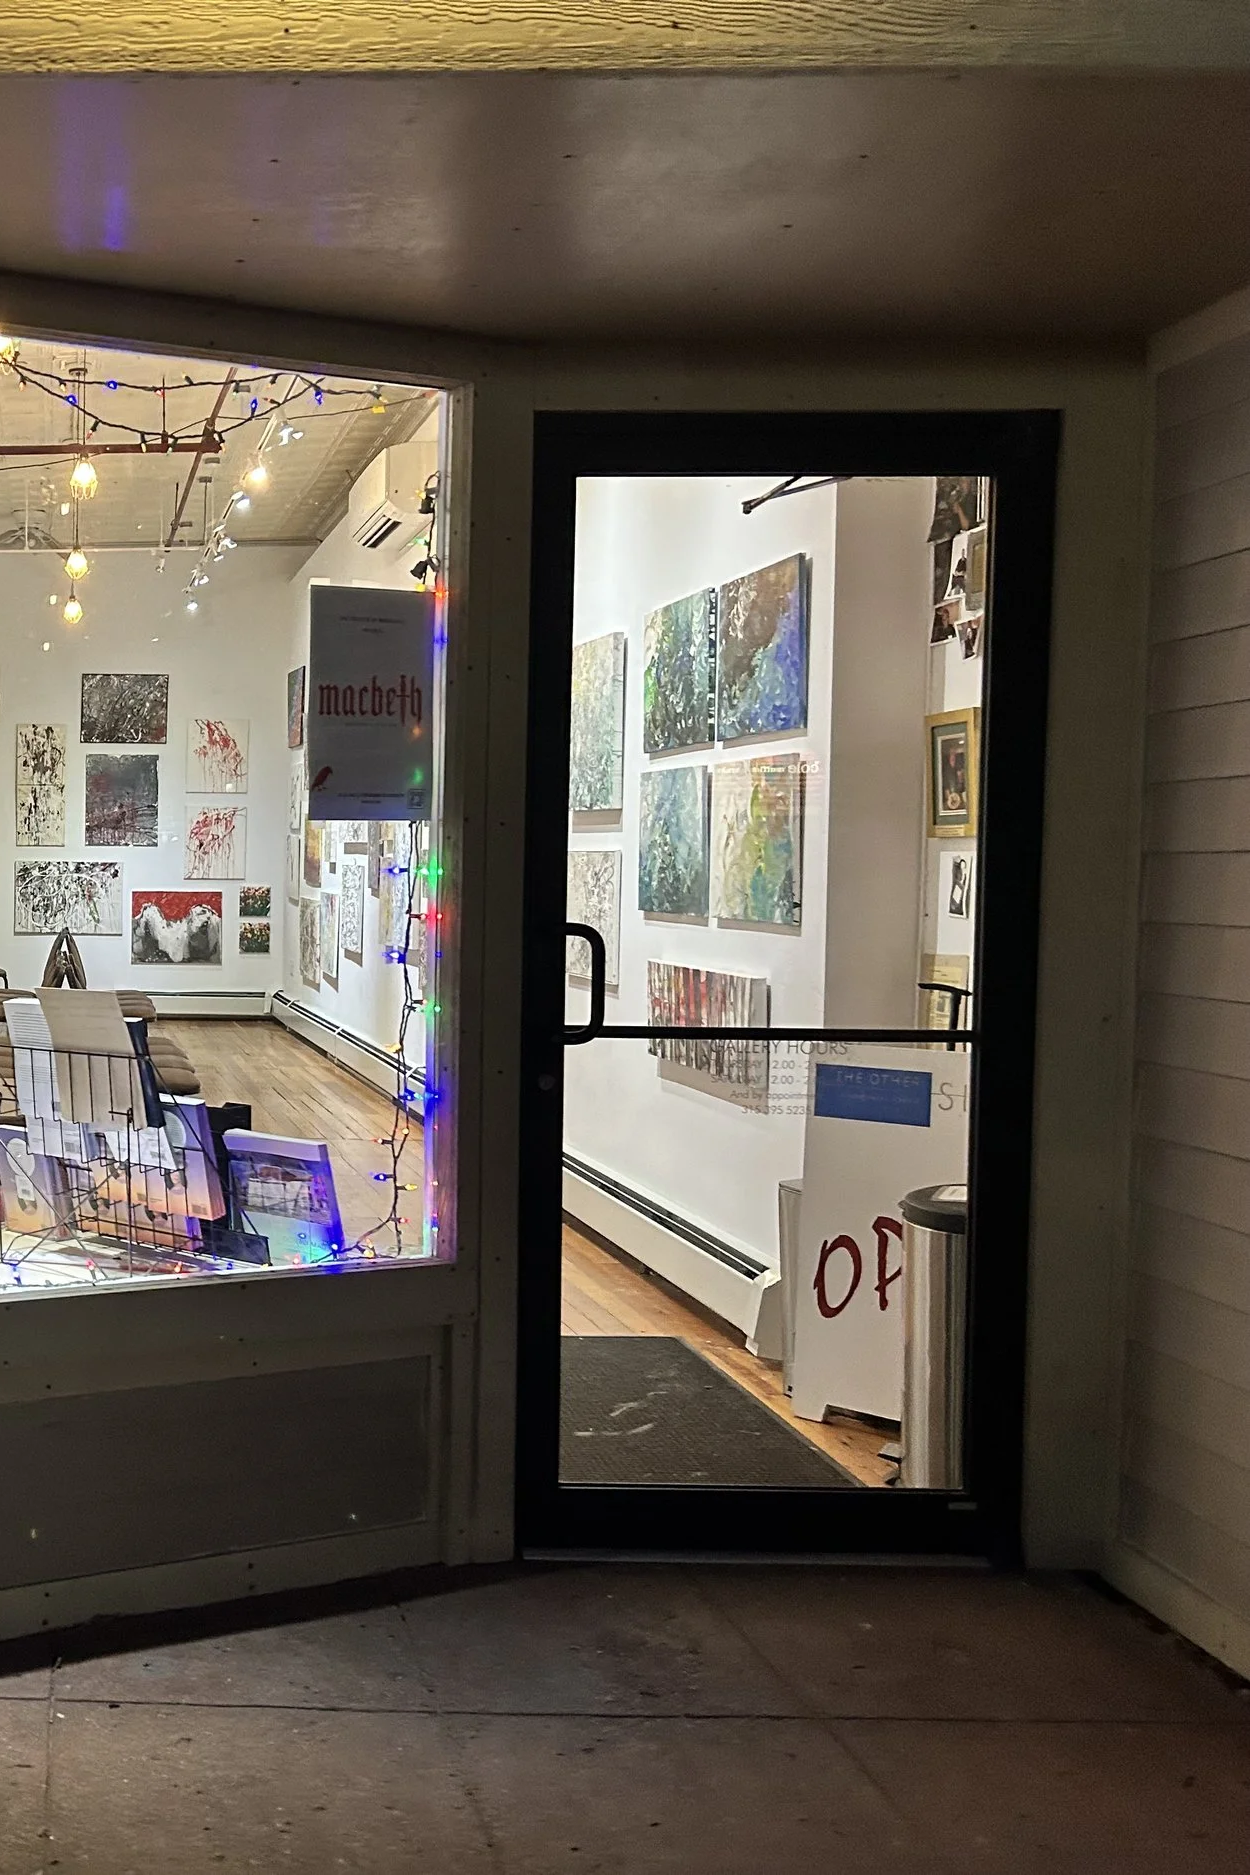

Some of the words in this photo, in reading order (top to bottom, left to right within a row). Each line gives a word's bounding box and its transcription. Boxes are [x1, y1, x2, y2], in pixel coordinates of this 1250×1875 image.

[318, 674, 423, 727] macbeth
[787, 1040, 848, 1055] HOURS
[836, 1070, 864, 1085] THE
[869, 1072, 920, 1089] OTHER
